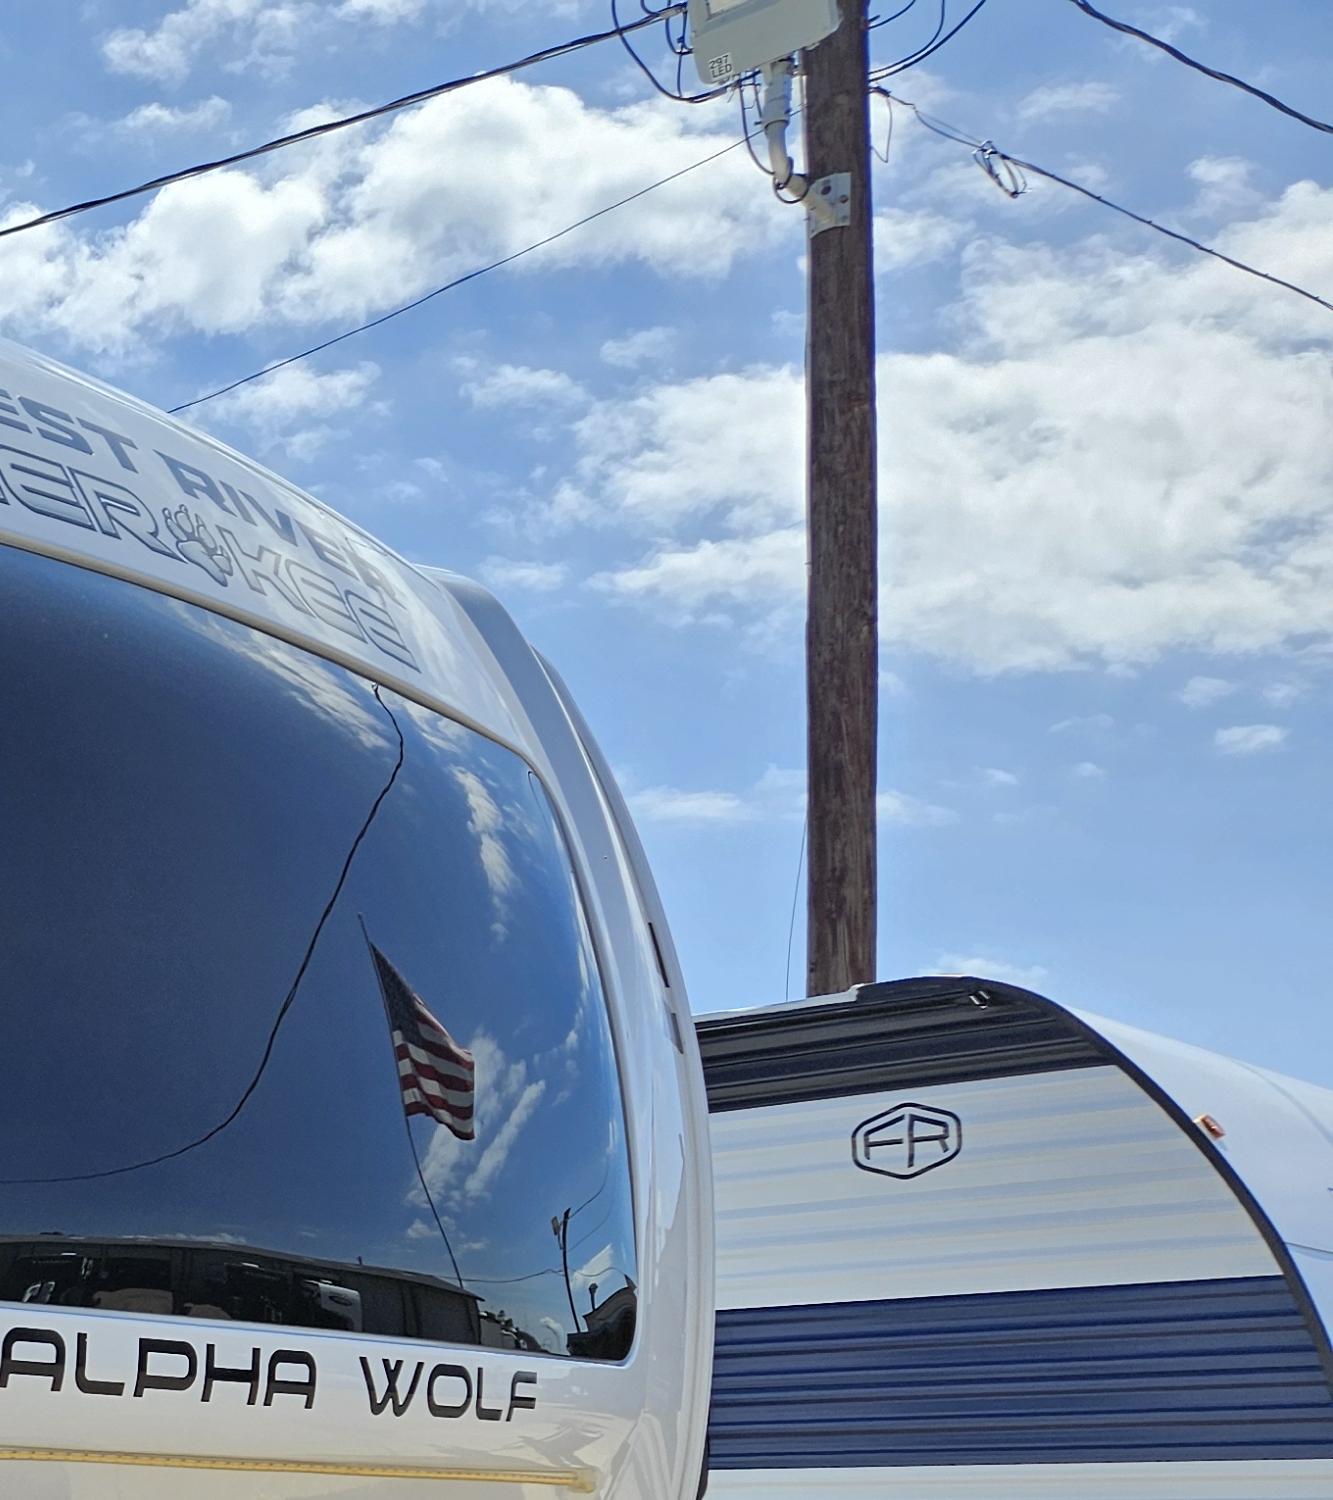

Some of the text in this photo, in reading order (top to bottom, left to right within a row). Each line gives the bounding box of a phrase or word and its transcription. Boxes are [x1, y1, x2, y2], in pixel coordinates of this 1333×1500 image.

[708, 54, 729, 69] 297
[712, 63, 732, 78] LED
[153, 448, 408, 611] RIVER
[358, 1354, 538, 1422] WOLF
